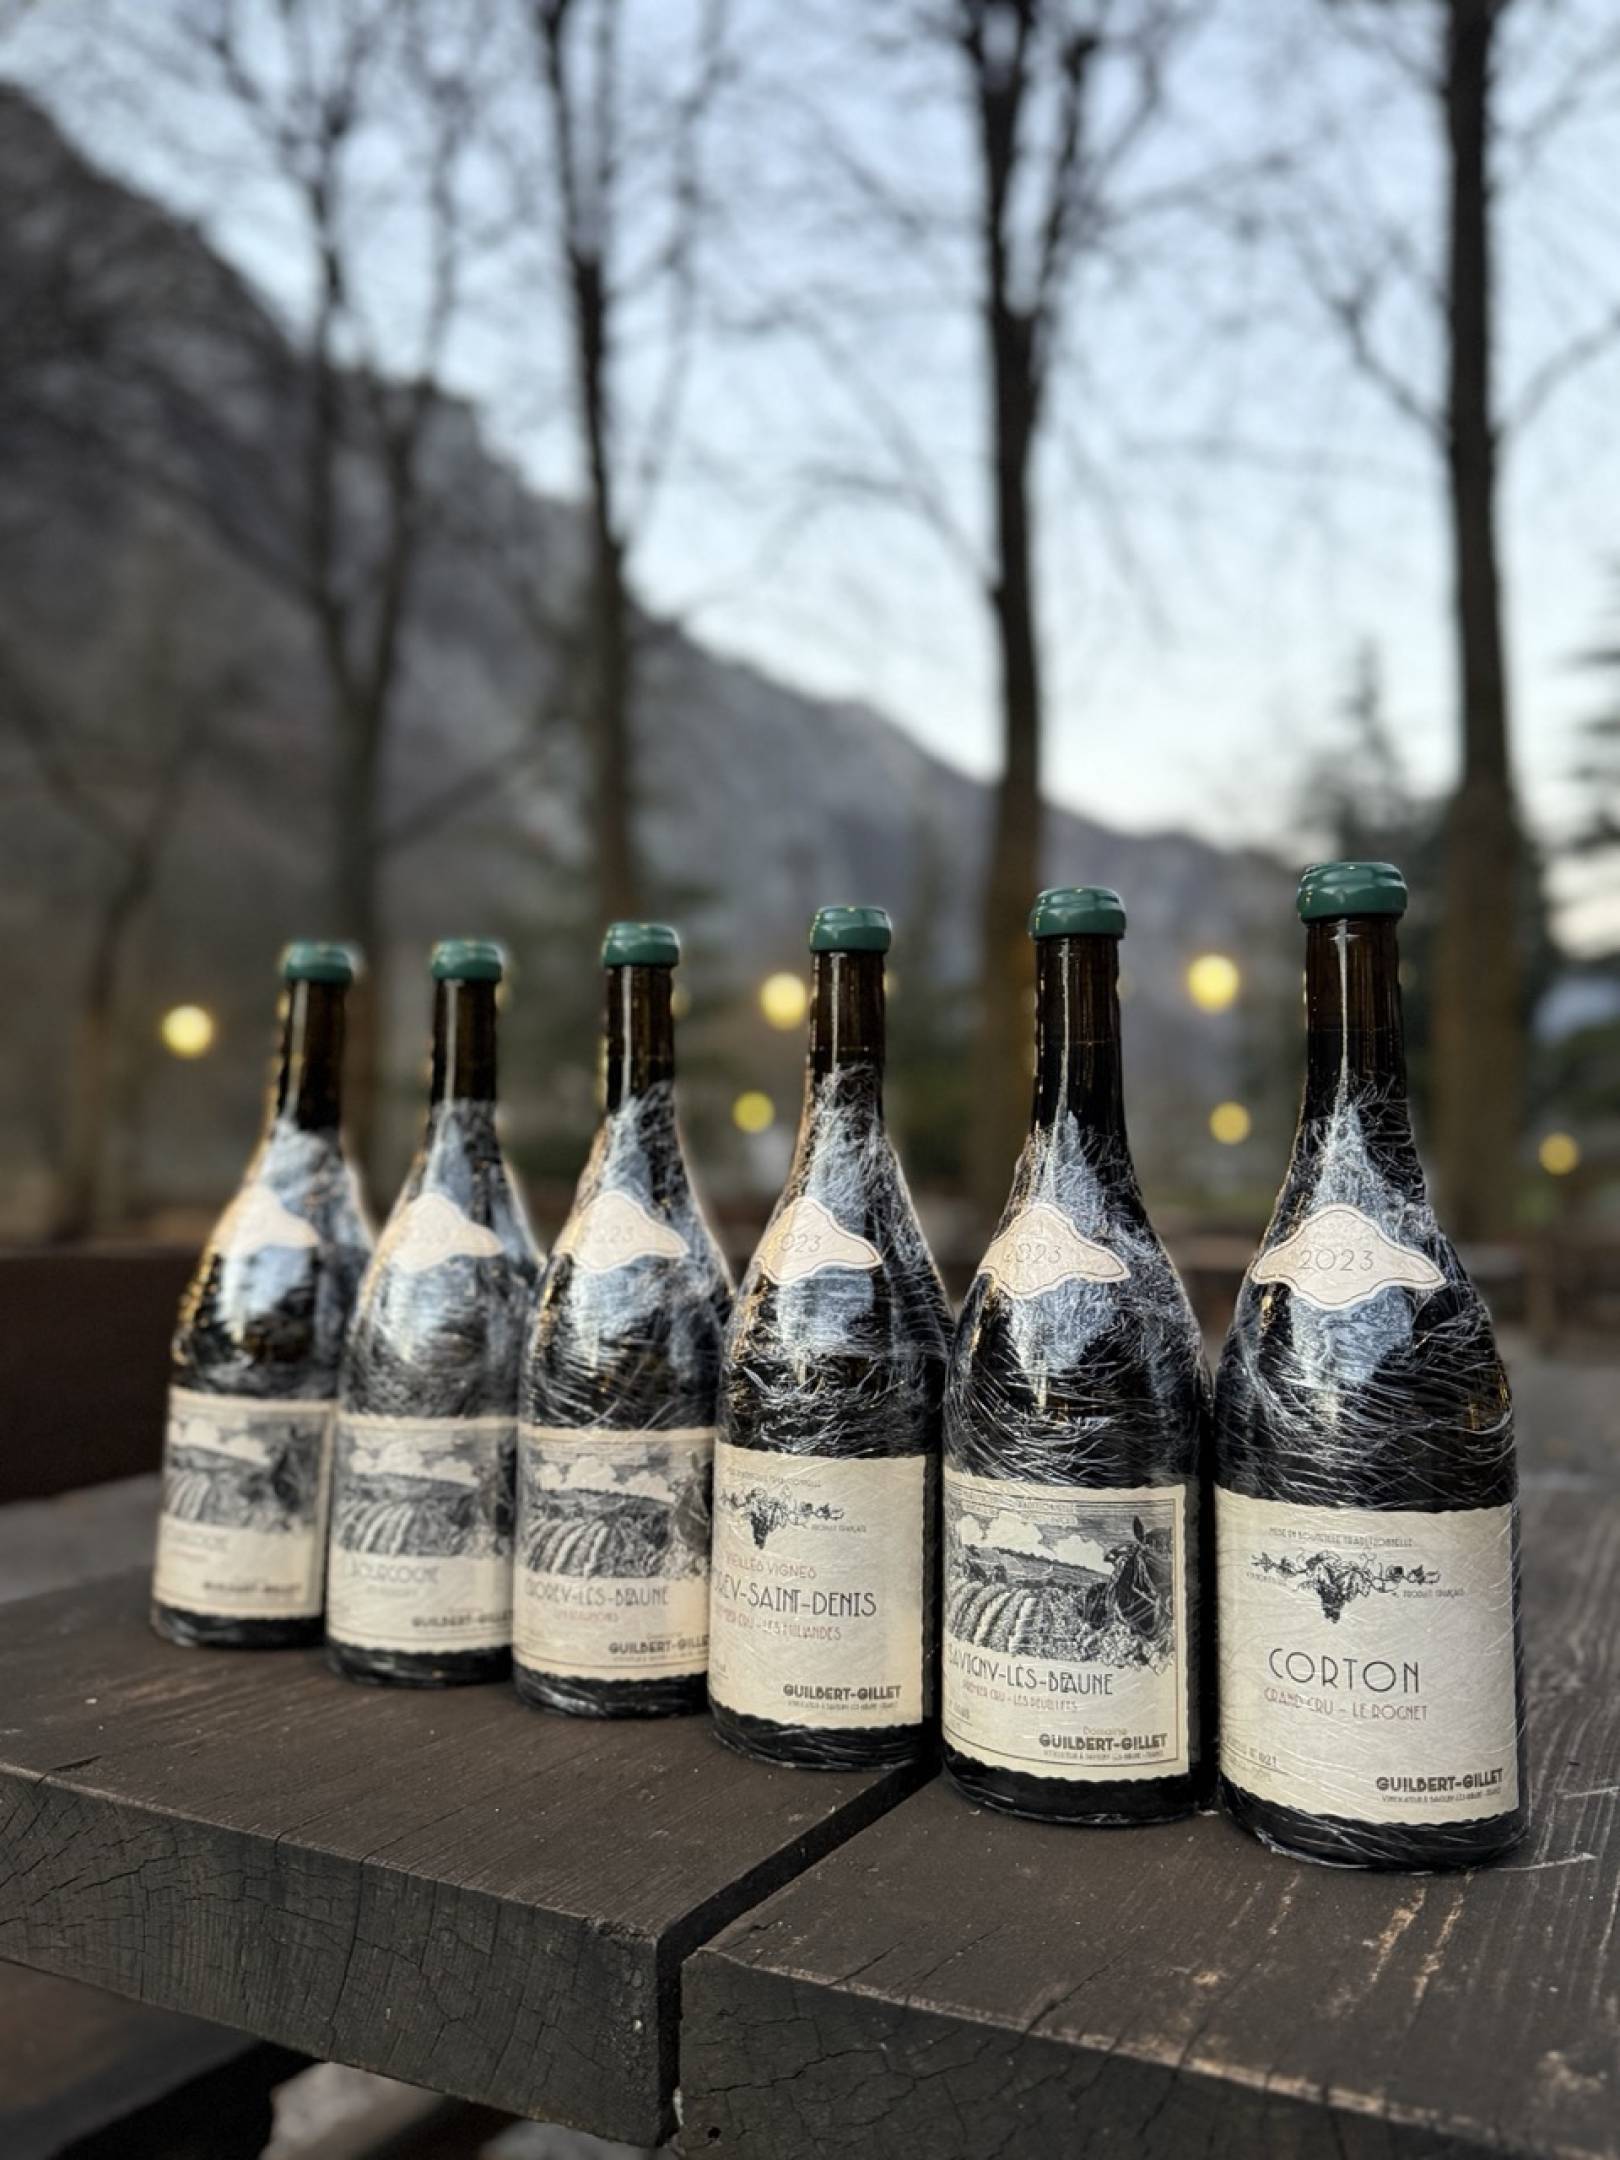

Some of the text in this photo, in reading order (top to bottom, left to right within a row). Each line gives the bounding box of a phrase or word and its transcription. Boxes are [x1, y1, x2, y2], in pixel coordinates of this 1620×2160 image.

[1298, 1248, 1374, 1271] 2023
[1269, 1648, 1419, 1694] CORTON
[783, 1684, 902, 1701] GUILBERT-GILLET
[1039, 1732, 1168, 1751] GUILBERT-GILLET
[1376, 1767, 1503, 1793] GUILBERT-GILLET
